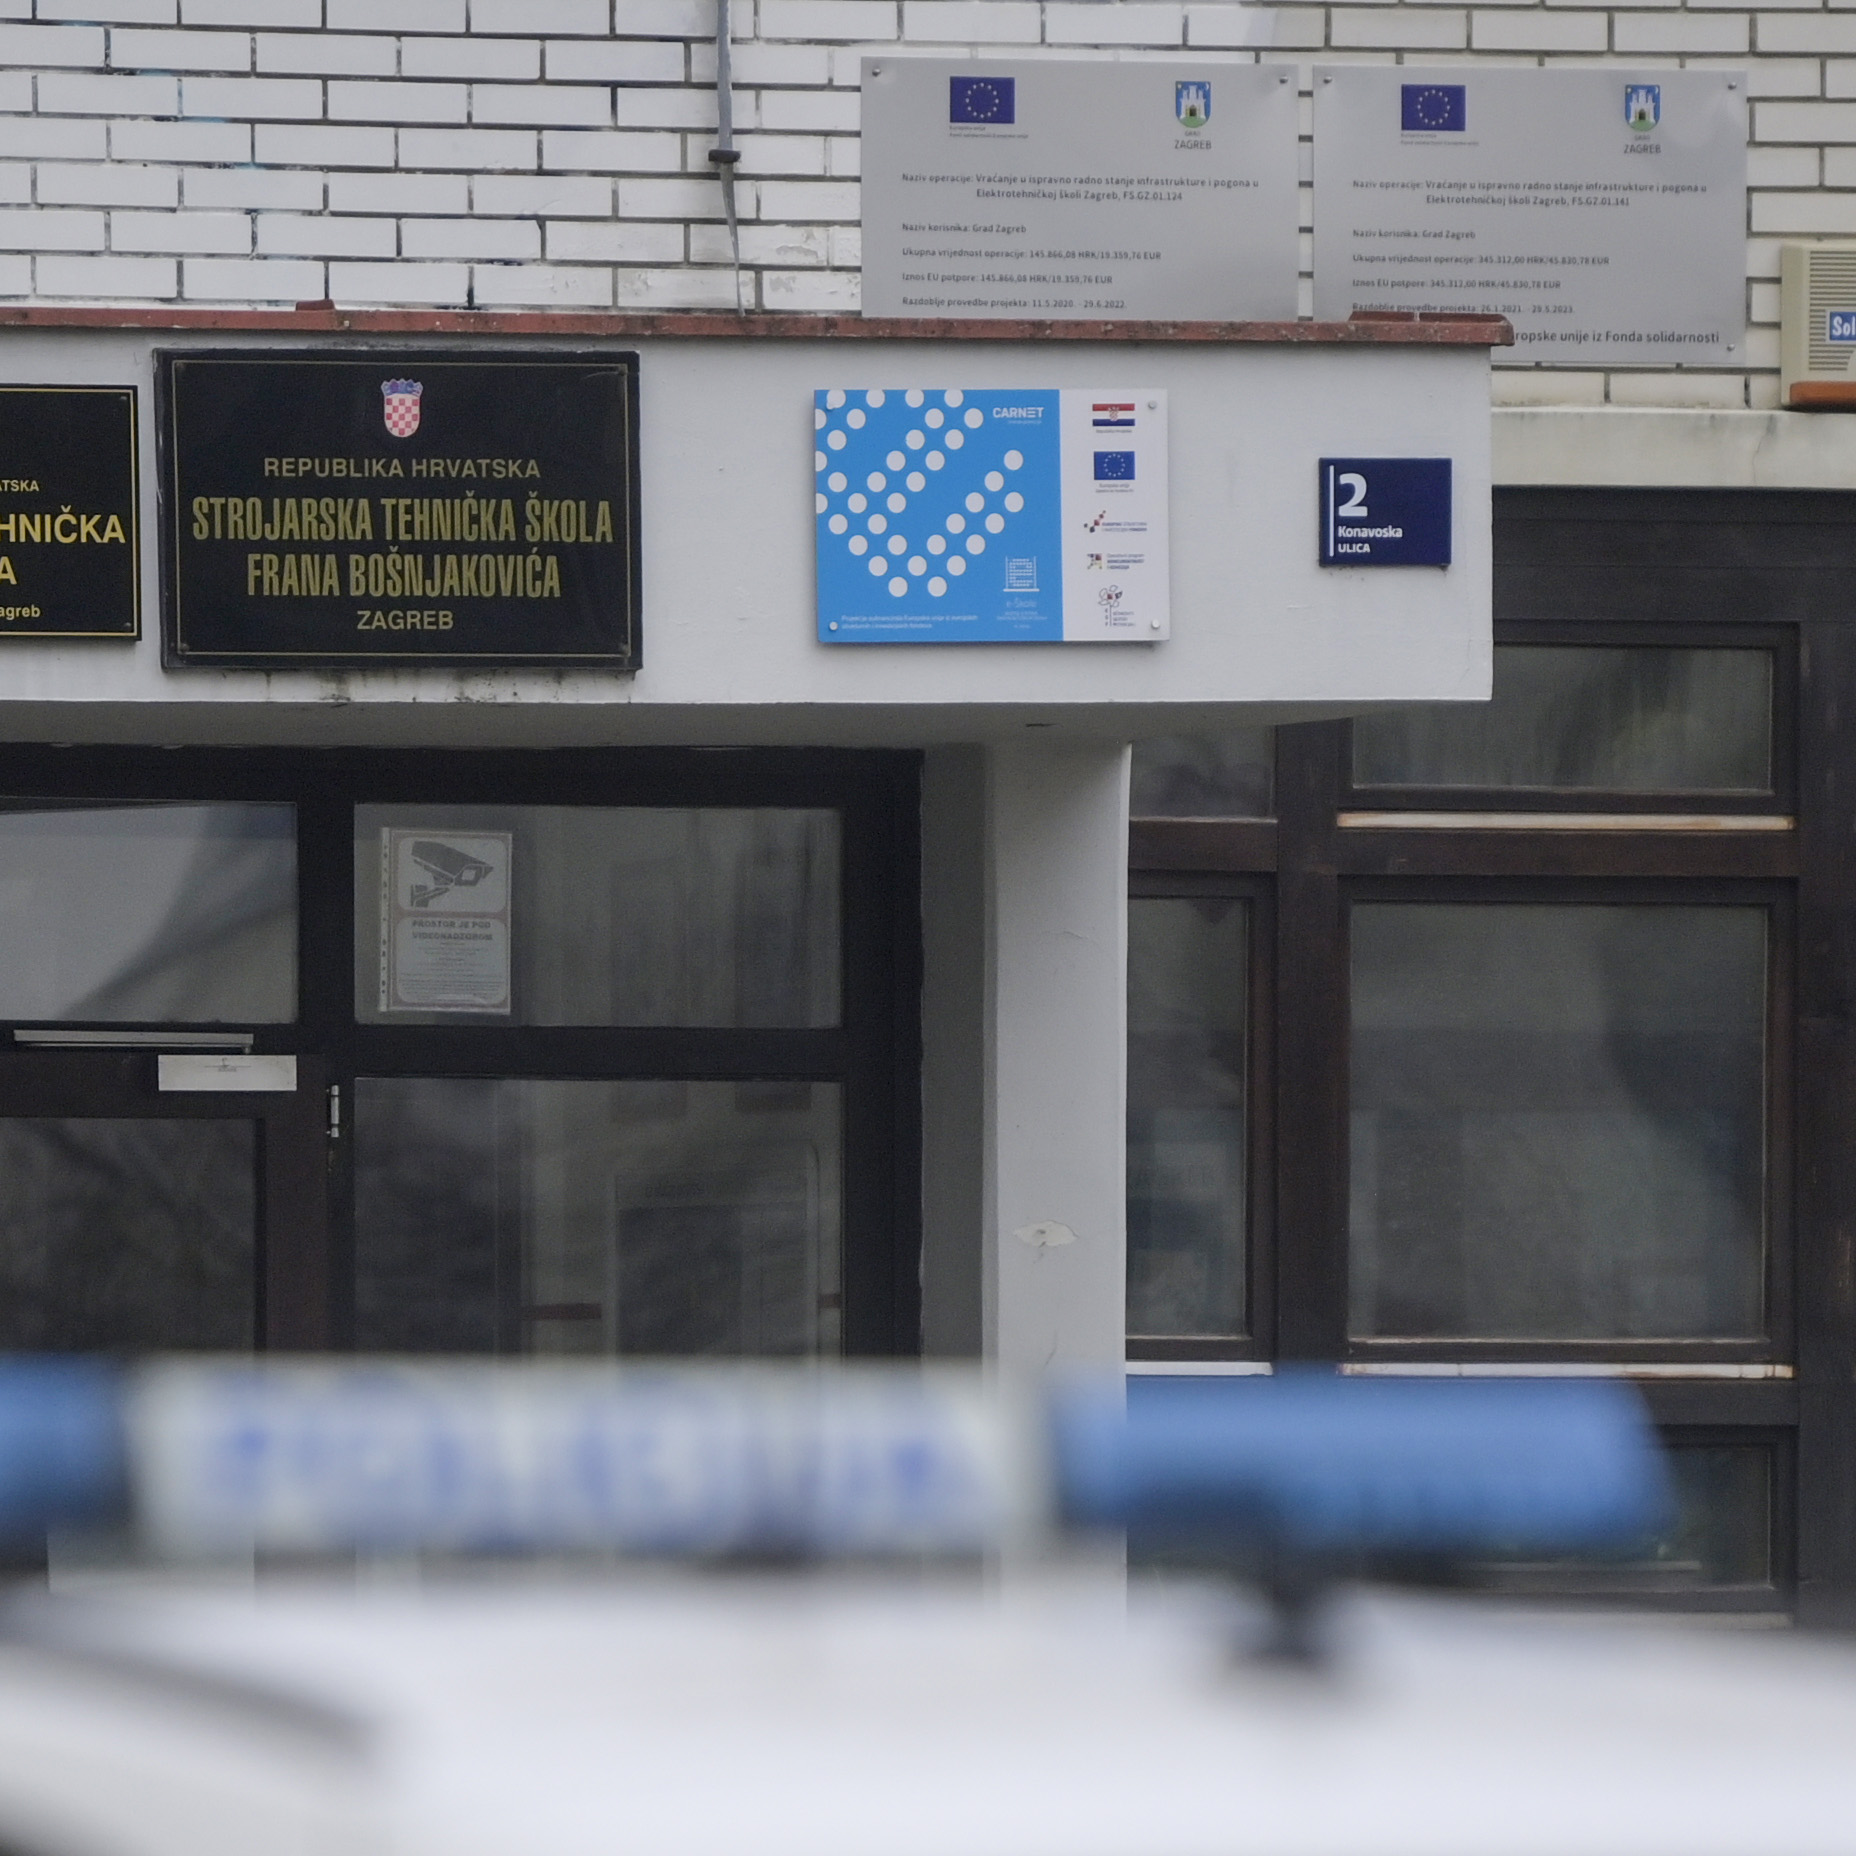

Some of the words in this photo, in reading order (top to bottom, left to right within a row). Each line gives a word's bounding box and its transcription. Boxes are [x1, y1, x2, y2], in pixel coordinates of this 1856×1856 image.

[1174, 139, 1212, 150] ZAGREB
[1623, 144, 1662, 154] ZAGREB
[902, 173, 926, 183] Naziv
[929, 174, 974, 185] operacije:
[976, 173, 1018, 185] Vraćanje
[1028, 175, 1072, 187] ispravno
[1074, 175, 1102, 185] radno
[1105, 176, 1135, 188] stanje
[1137, 176, 1206, 188] infrastrukture
[1214, 179, 1250, 189] pogona
[1353, 179, 1377, 189] Naziv
[1379, 180, 1424, 191] operacije:
[1425, 180, 1468, 192] Vraćanje
[1478, 181, 1521, 193] ispravno
[1523, 181, 1551, 191] radno
[1554, 182, 1584, 194] stanje
[1586, 182, 1655, 193] infrastrukture
[1662, 185, 1698, 195] pogona
[976, 187, 1057, 200] Elektrotehničkoj
[1059, 189, 1082, 200] školi
[1083, 189, 1120, 201] Zagreb,
[1426, 195, 1506, 206] Elektrotehničkoj
[1508, 195, 1531, 206] školi
[1533, 196, 1569, 207] Zagreb,
[902, 223, 926, 233] Naziv
[928, 223, 970, 233] korisnika:
[972, 224, 994, 233] Grad
[995, 224, 1027, 235] Zagreb
[1353, 229, 1377, 239] Naziv
[1422, 229, 1443, 239] Grad
[1445, 230, 1476, 241] Zagreb
[902, 247, 936, 259] Ukupna
[938, 248, 983, 259] vrijednost
[984, 249, 1027, 260] operacije:
[1144, 251, 1162, 260] EUR
[1353, 254, 1386, 265] Ukupna
[1388, 254, 1432, 265] vrijednost
[1434, 255, 1477, 266] operacije:
[1591, 257, 1610, 266] EUR
[902, 272, 925, 282] Iznos
[927, 273, 939, 282] EU
[940, 274, 979, 284] potpore:
[1095, 275, 1113, 284] EUR
[1353, 278, 1376, 288] Iznos
[1377, 279, 1389, 288] EU
[1391, 279, 1429, 290] potpore:
[1543, 280, 1561, 289] EUR
[902, 296, 946, 308] Razdoblje
[947, 297, 989, 308] provedbe
[991, 297, 1029, 309] projekta:
[1515, 330, 1557, 344] ropske
[1560, 330, 1591, 344] unije
[1593, 330, 1603, 342] iz
[1605, 330, 1643, 343] Fonda
[1646, 331, 1720, 344] solidarnosti
[992, 406, 1045, 419] CARNET
[263, 457, 404, 479] REPUBLIKA
[411, 458, 541, 480] HRVATSKA
[1337, 472, 1368, 518] 2
[192, 496, 373, 544] STROJARSKA
[380, 491, 516, 544] TEHNIČKA
[524, 492, 614, 544] ŠKOLA
[1337, 525, 1403, 540] Konavoska
[1337, 542, 1371, 554] ULICA
[246, 552, 342, 597] FRANA
[349, 548, 562, 599] BOŠNJAKOVIĆA
[356, 610, 455, 631] ZAGREB
